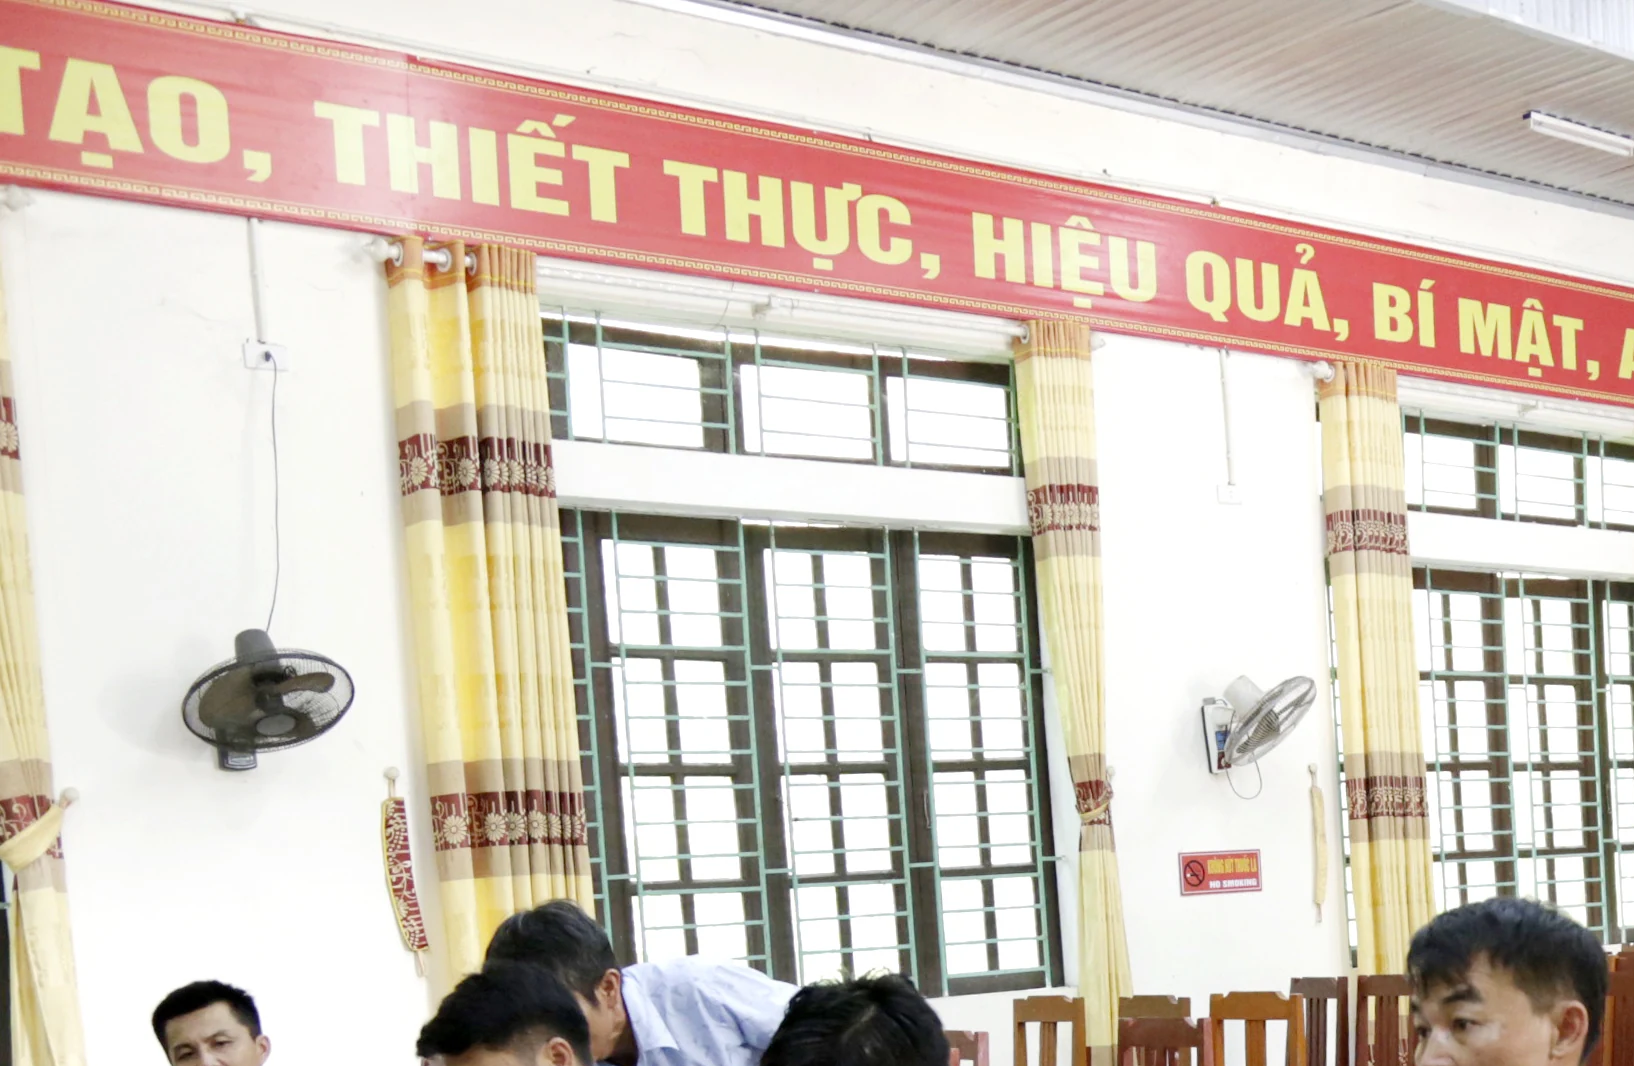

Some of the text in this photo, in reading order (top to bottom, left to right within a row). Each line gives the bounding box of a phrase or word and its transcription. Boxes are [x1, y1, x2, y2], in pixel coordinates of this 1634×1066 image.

[0, 46, 272, 182] TẠO,
[313, 114, 631, 225] THIẾT
[662, 160, 941, 280] THỰC,
[972, 213, 1158, 309] HIỆU
[1185, 243, 1350, 342] QUẢ,
[1371, 279, 1436, 348] BÍ
[1457, 297, 1600, 381] MẬT,
[1209, 878, 1258, 889] NO SMOKING
